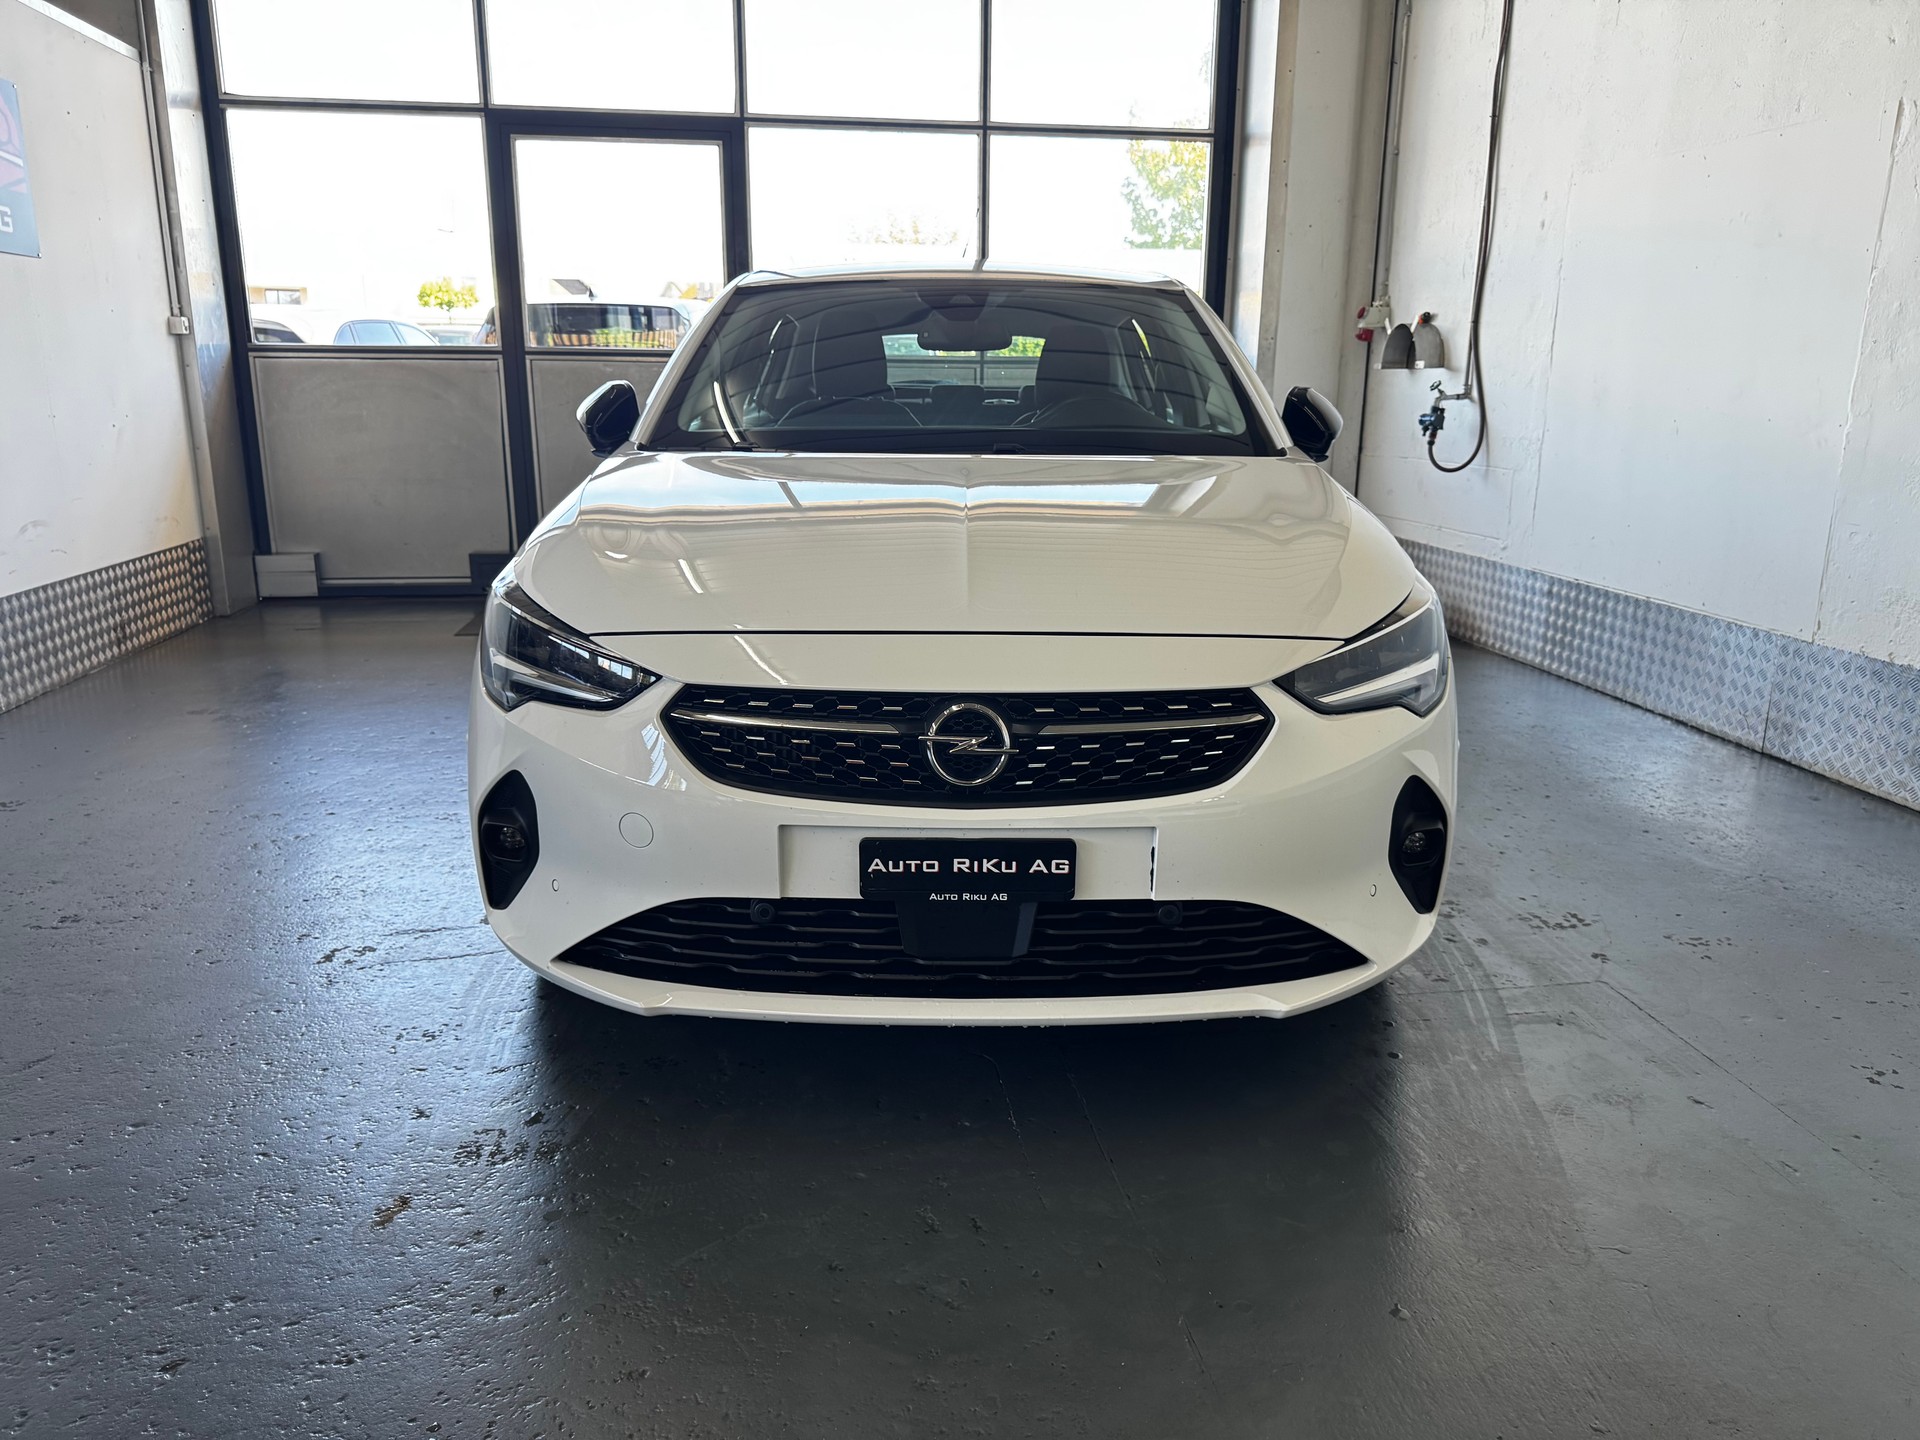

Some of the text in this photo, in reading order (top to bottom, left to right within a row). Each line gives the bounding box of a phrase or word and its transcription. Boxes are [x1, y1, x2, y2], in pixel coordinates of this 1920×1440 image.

[867, 858, 940, 873] AUTO
[1028, 859, 1070, 874] AG
[929, 892, 958, 901] AUTO
[990, 892, 1008, 901] AG
